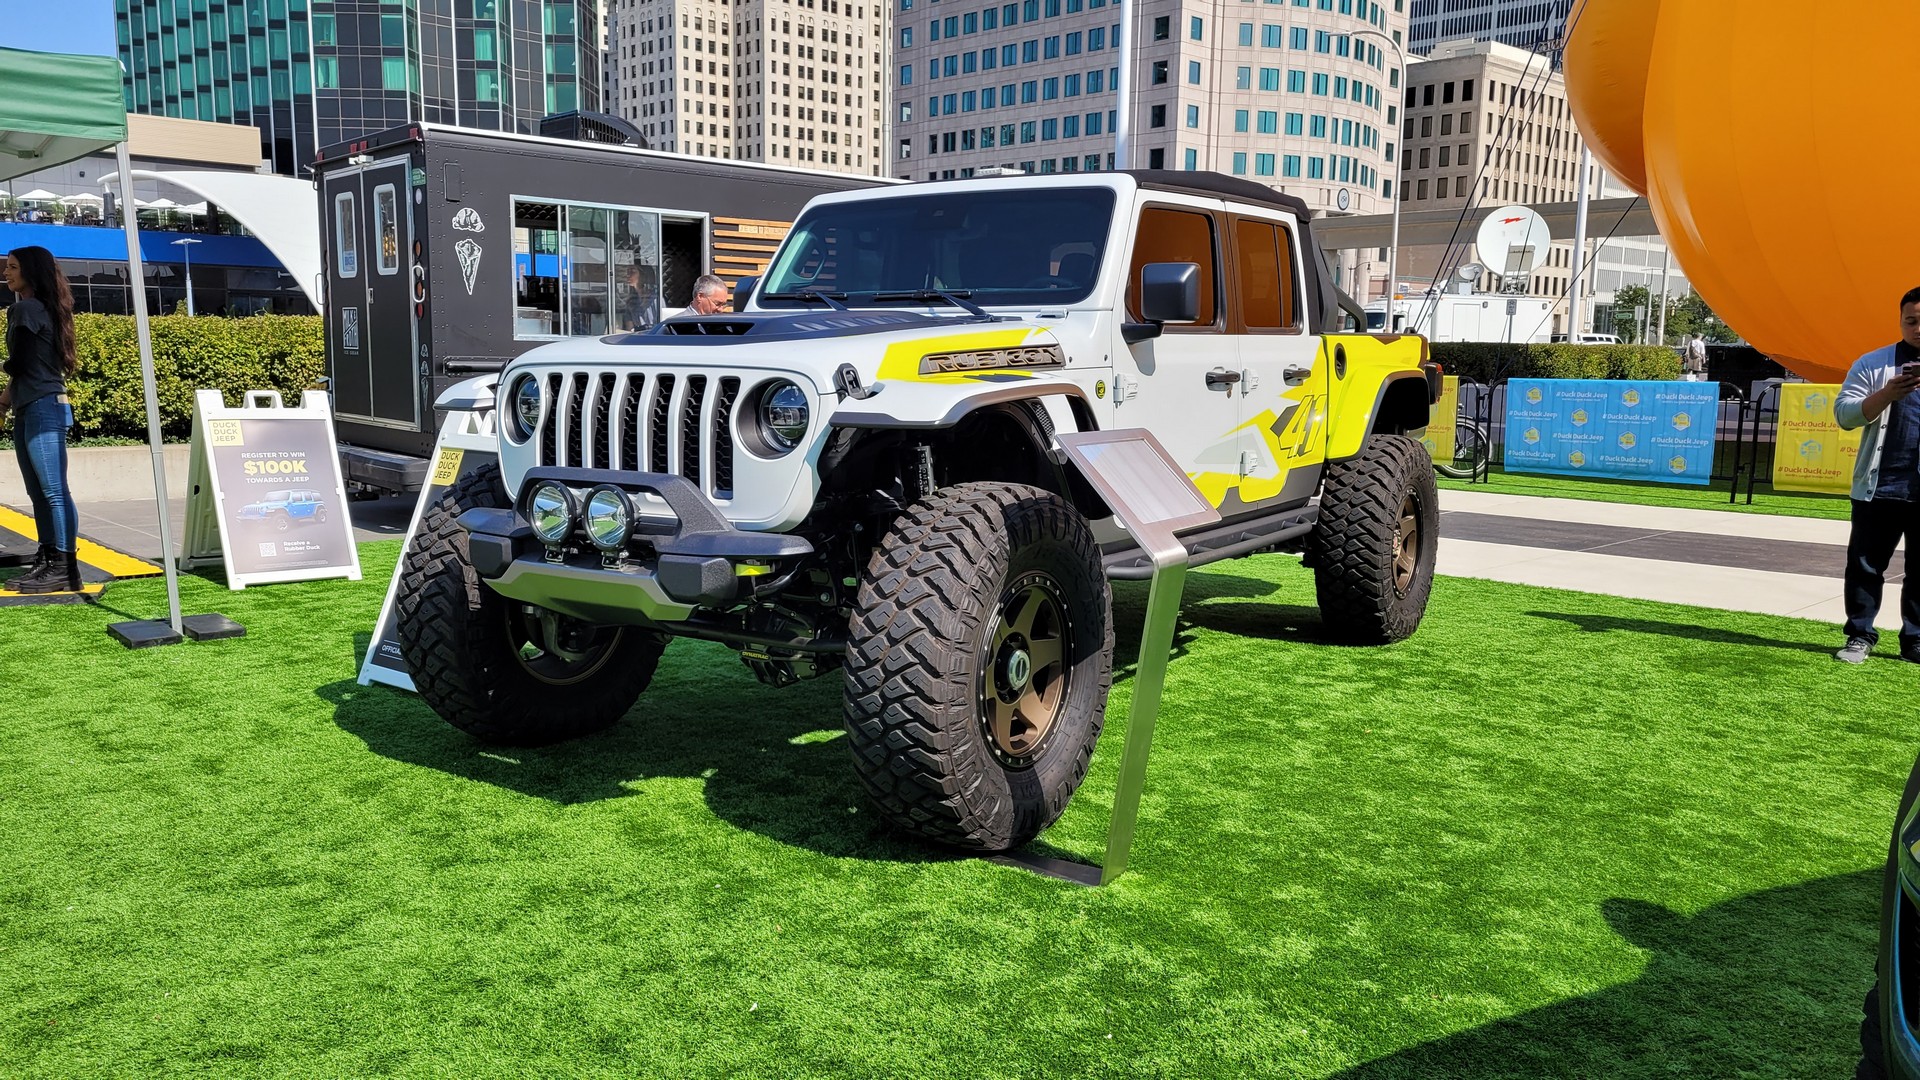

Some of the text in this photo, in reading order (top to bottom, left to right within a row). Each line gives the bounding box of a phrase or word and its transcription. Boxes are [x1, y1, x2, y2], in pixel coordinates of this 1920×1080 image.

[927, 346, 1062, 372] RUBICON
[1271, 394, 1327, 458] 41
[441, 452, 460, 461] DUCK
[244, 460, 308, 476] $100K
[438, 461, 458, 470] DUCK
[435, 471, 452, 479] JEEP
[1823, 468, 1842, 477] Jeep
[382, 644, 401, 655] OFFICIA
